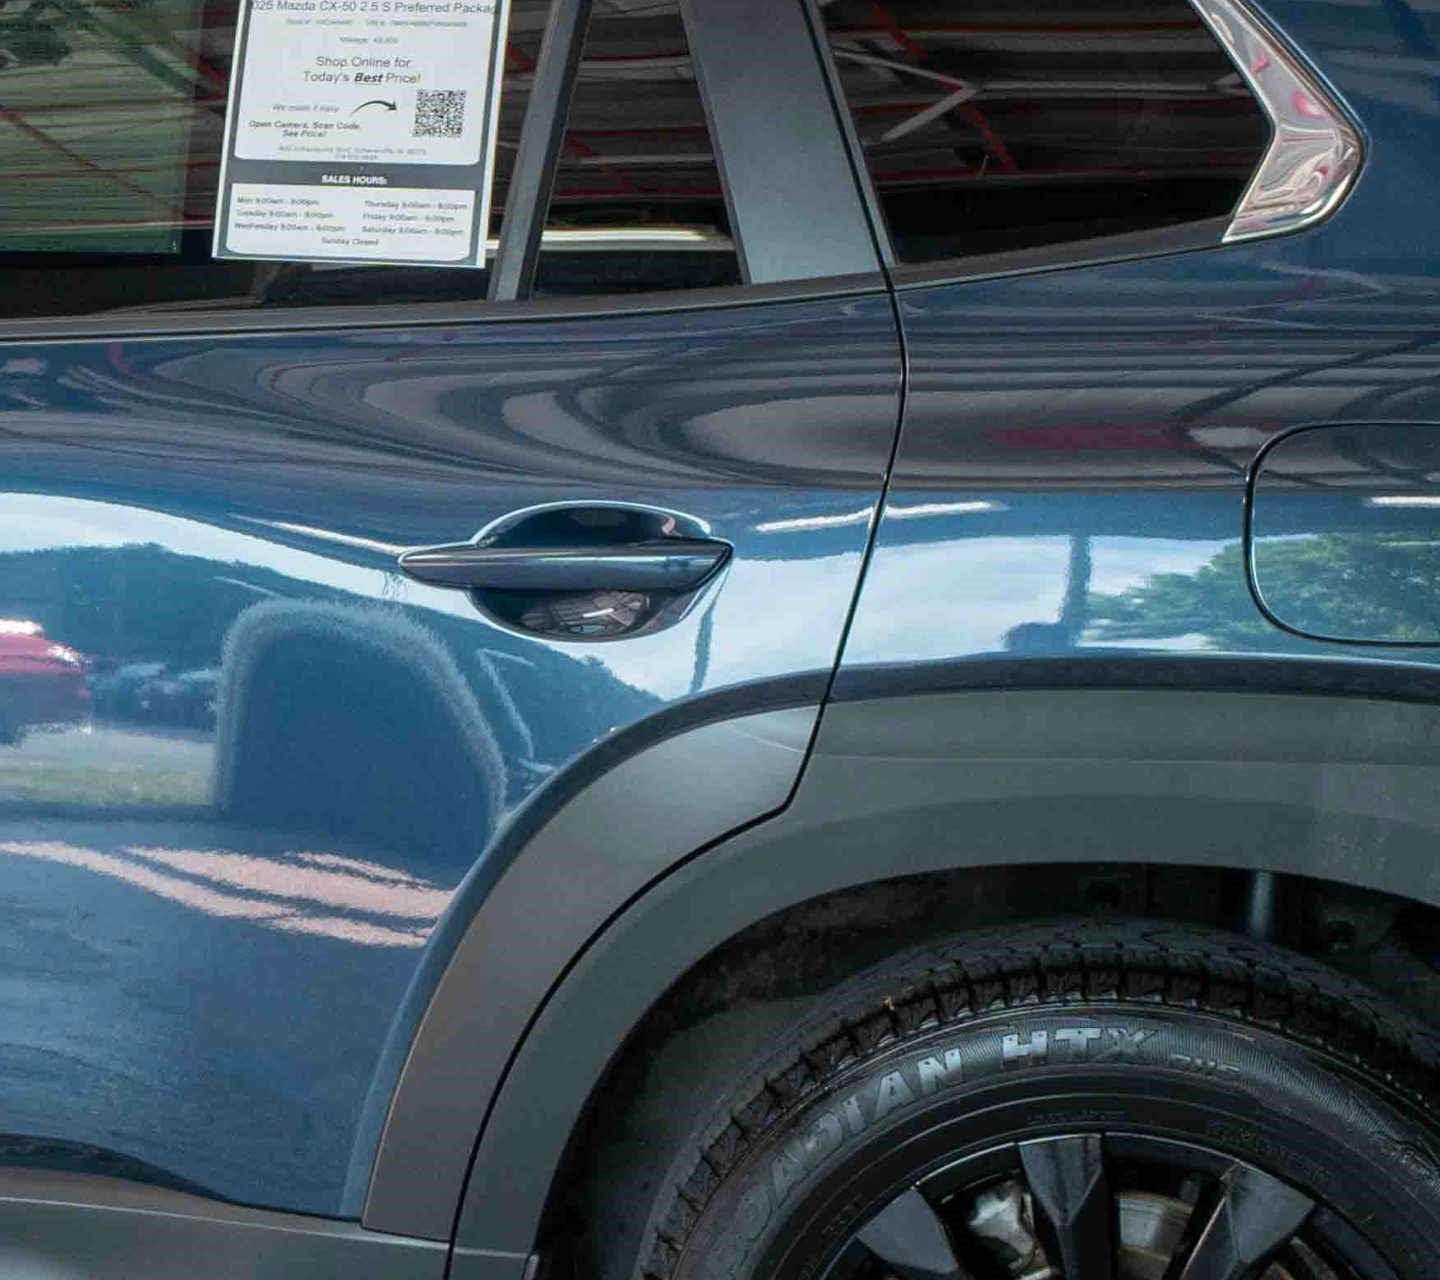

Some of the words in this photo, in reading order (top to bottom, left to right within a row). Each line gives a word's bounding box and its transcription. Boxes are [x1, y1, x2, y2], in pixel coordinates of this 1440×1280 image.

[253, 0, 273, 11] 025
[277, 0, 316, 12] Mazda
[320, 0, 357, 13] CX-50
[360, 1, 379, 13] 2.5
[383, 1, 392, 13] S
[395, 1, 450, 14] Preferred
[316, 55, 348, 69] Shop
[352, 56, 391, 68] Online
[394, 56, 413, 68] for
[304, 70, 350, 84] Today's
[353, 72, 384, 84] Best
[385, 72, 421, 84] Price!
[249, 120, 270, 130] Open
[313, 121, 334, 130] Scan
[282, 129, 298, 138] See
[321, 174, 351, 184] SALES
[352, 175, 388, 186] HOURS:
[364, 200, 400, 209] Thursday
[362, 212, 387, 222] Friday
[234, 222, 278, 232] Wednesday
[362, 226, 397, 235] Saturday
[321, 237, 350, 246] Sunday
[1002, 1027, 1160, 1070] HTX
